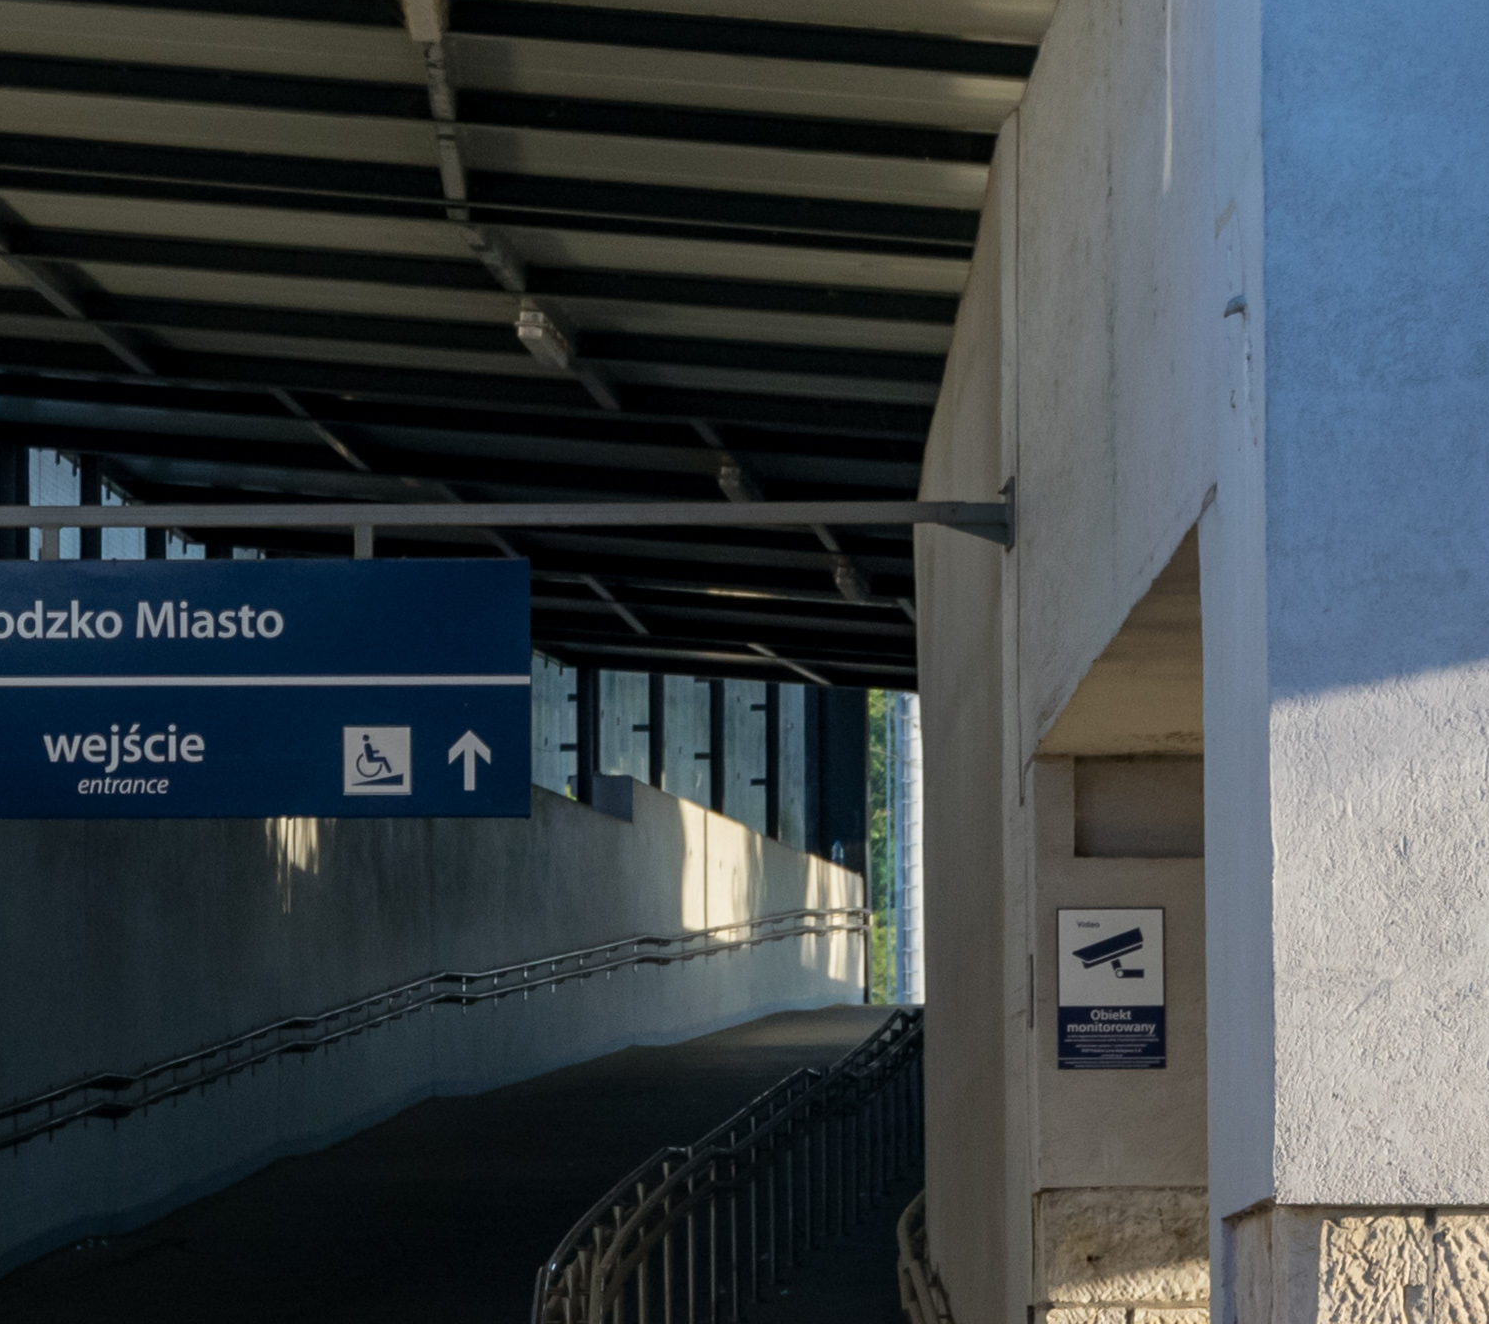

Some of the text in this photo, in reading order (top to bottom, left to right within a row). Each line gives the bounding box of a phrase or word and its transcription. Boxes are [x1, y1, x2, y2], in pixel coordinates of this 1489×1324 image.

[135, 600, 285, 639] Miasto
[43, 723, 206, 774] wejście
[77, 777, 170, 795] entrance
[1090, 1009, 1132, 1021] Obiekt
[1066, 1022, 1157, 1035] monitorowany
